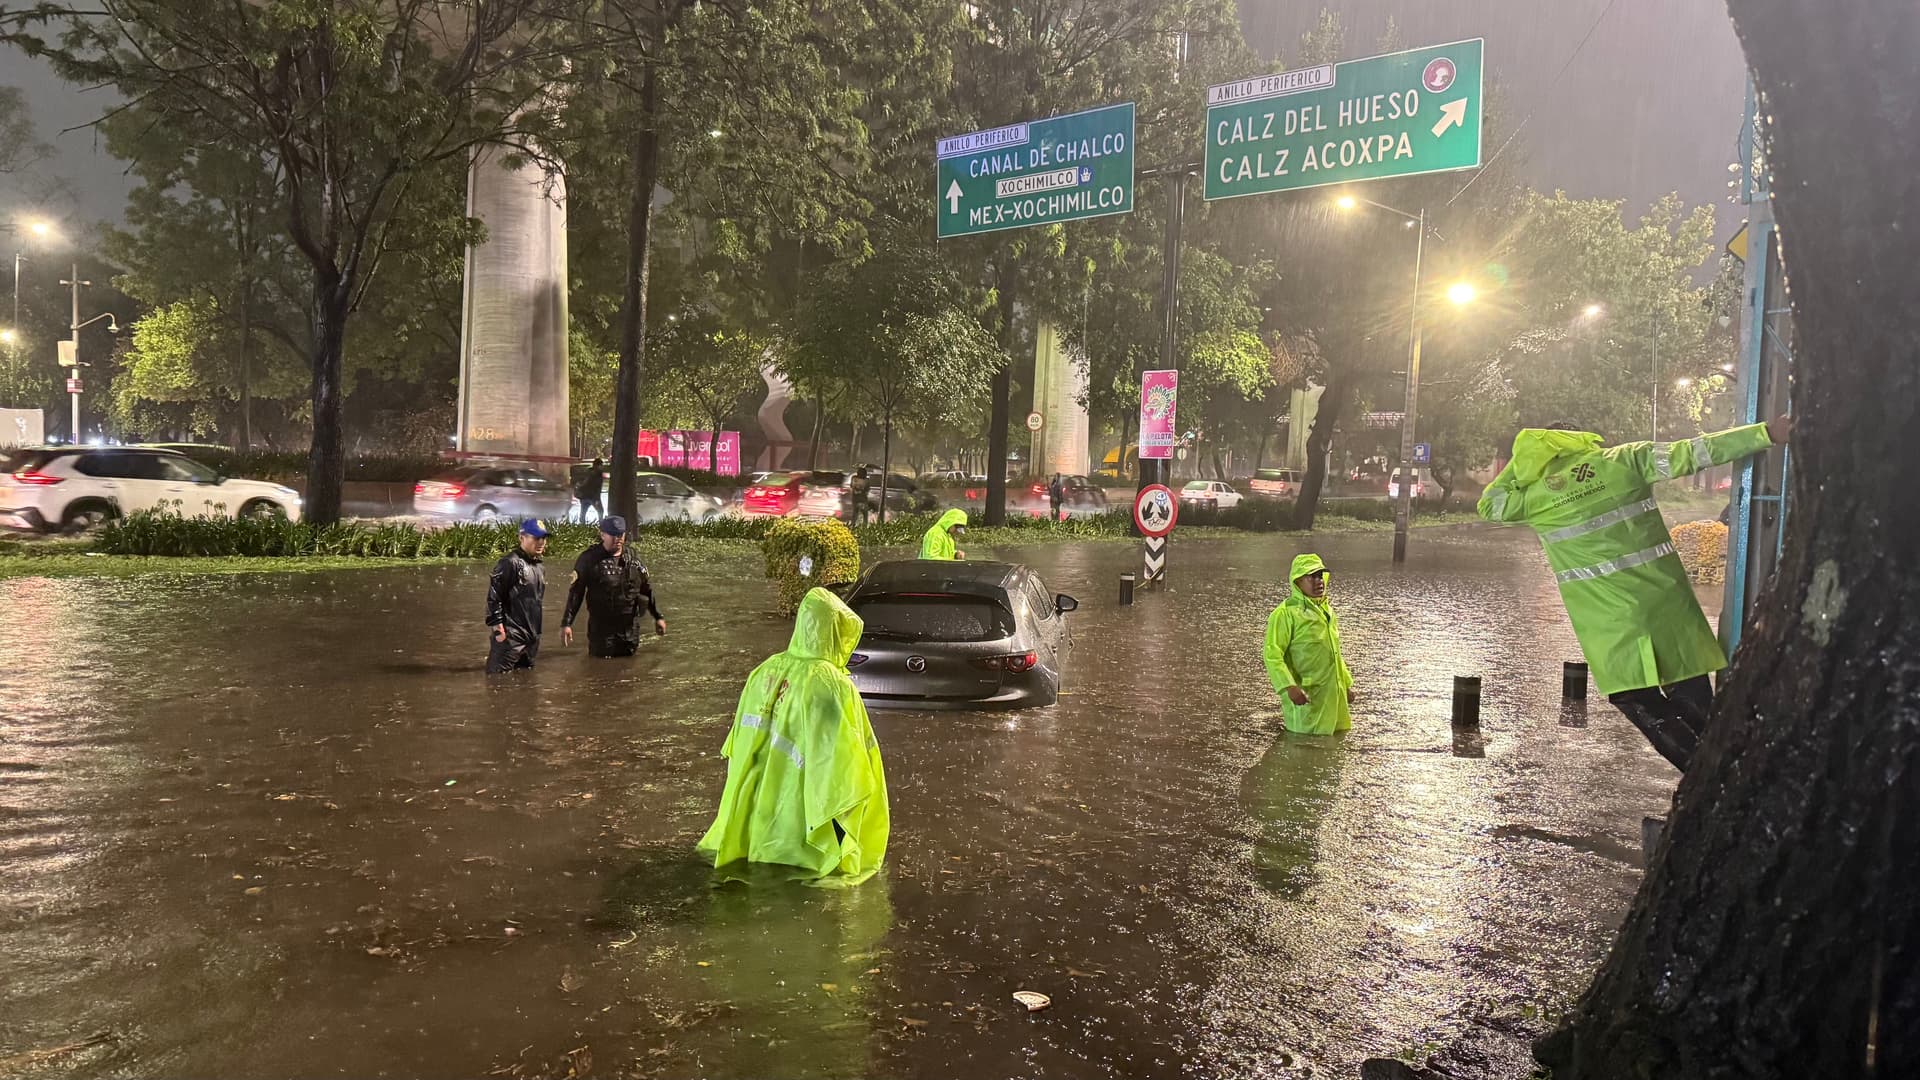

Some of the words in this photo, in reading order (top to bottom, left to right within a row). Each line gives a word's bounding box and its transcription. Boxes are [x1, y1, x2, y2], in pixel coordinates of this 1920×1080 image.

[1217, 82, 1252, 100] ANILLO
[1260, 69, 1321, 93] PERIFERICO
[1217, 112, 1275, 146] CALZ
[1285, 104, 1327, 136] DEL
[1339, 89, 1419, 128] HUESO
[944, 138, 970, 153] ANILLO
[975, 128, 1019, 148] PERIFERICO
[969, 151, 1023, 178] CANAL
[1030, 147, 1050, 167] DE
[1056, 133, 1125, 163] CHALCO
[1220, 149, 1289, 184] CALZ
[1302, 132, 1414, 173] ACOXPA
[1001, 171, 1074, 194] XOCHIMILCO
[969, 186, 1124, 227] MEX-XOCHIMILCO
[686, 439, 730, 452] iverool
